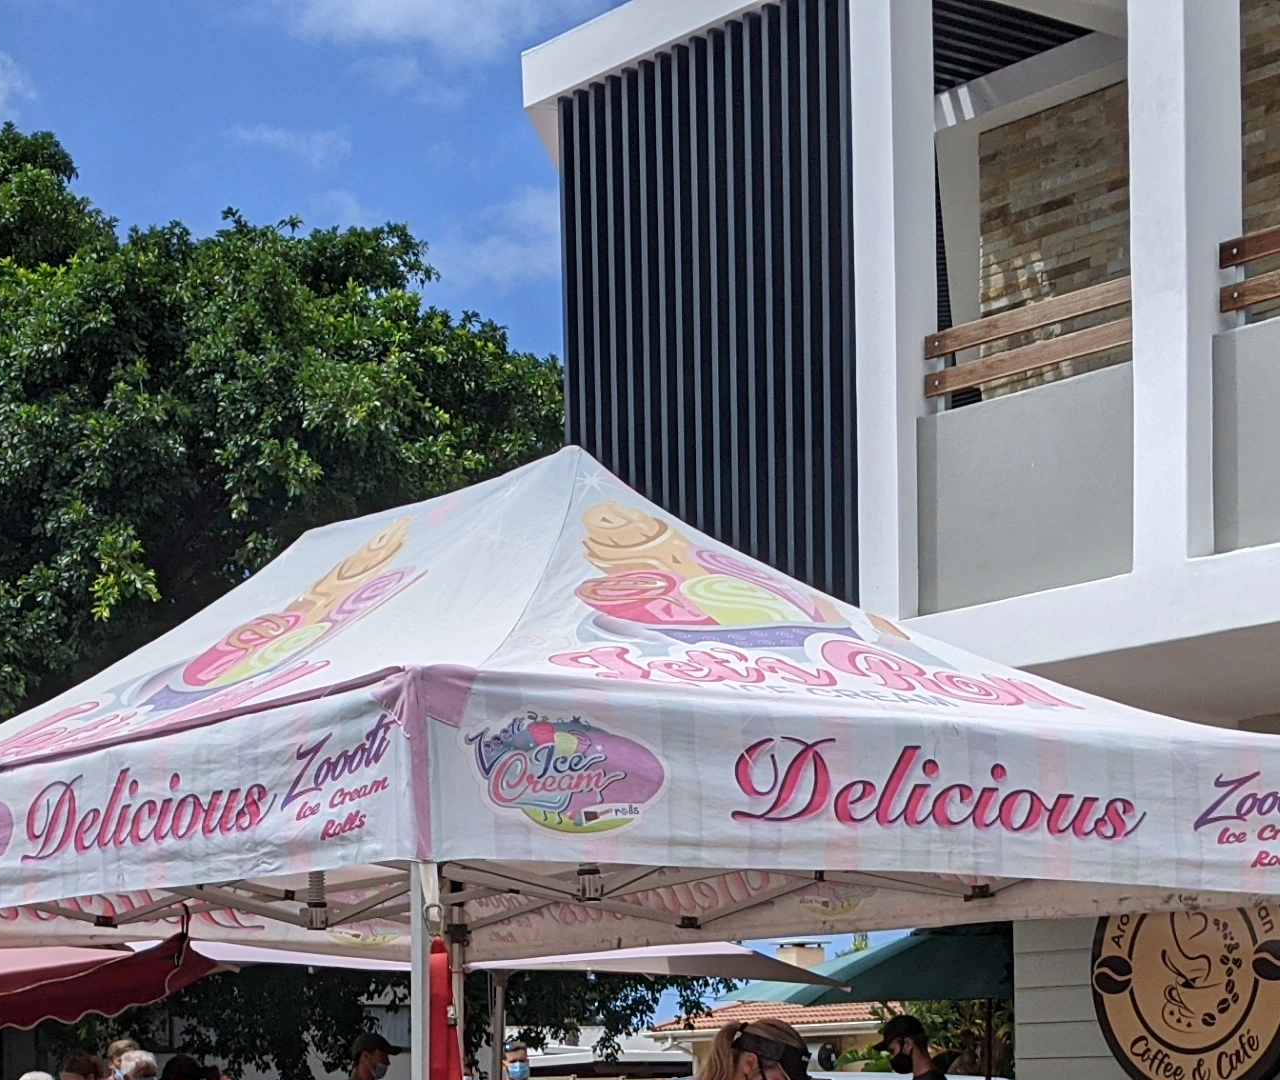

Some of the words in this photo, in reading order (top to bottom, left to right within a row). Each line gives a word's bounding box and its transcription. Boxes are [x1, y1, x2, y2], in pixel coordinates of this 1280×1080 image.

[490, 752, 627, 805] Cream
[534, 745, 607, 779] Ice
[296, 801, 320, 821] Ice
[329, 777, 389, 809] Cream
[731, 736, 1147, 840] Delicious
[21, 767, 277, 863] Delicious
[320, 810, 367, 841] Rolls
[614, 805, 640, 816] rolls
[1217, 827, 1247, 844] Ice
[1216, 1029, 1260, 1080] Café
